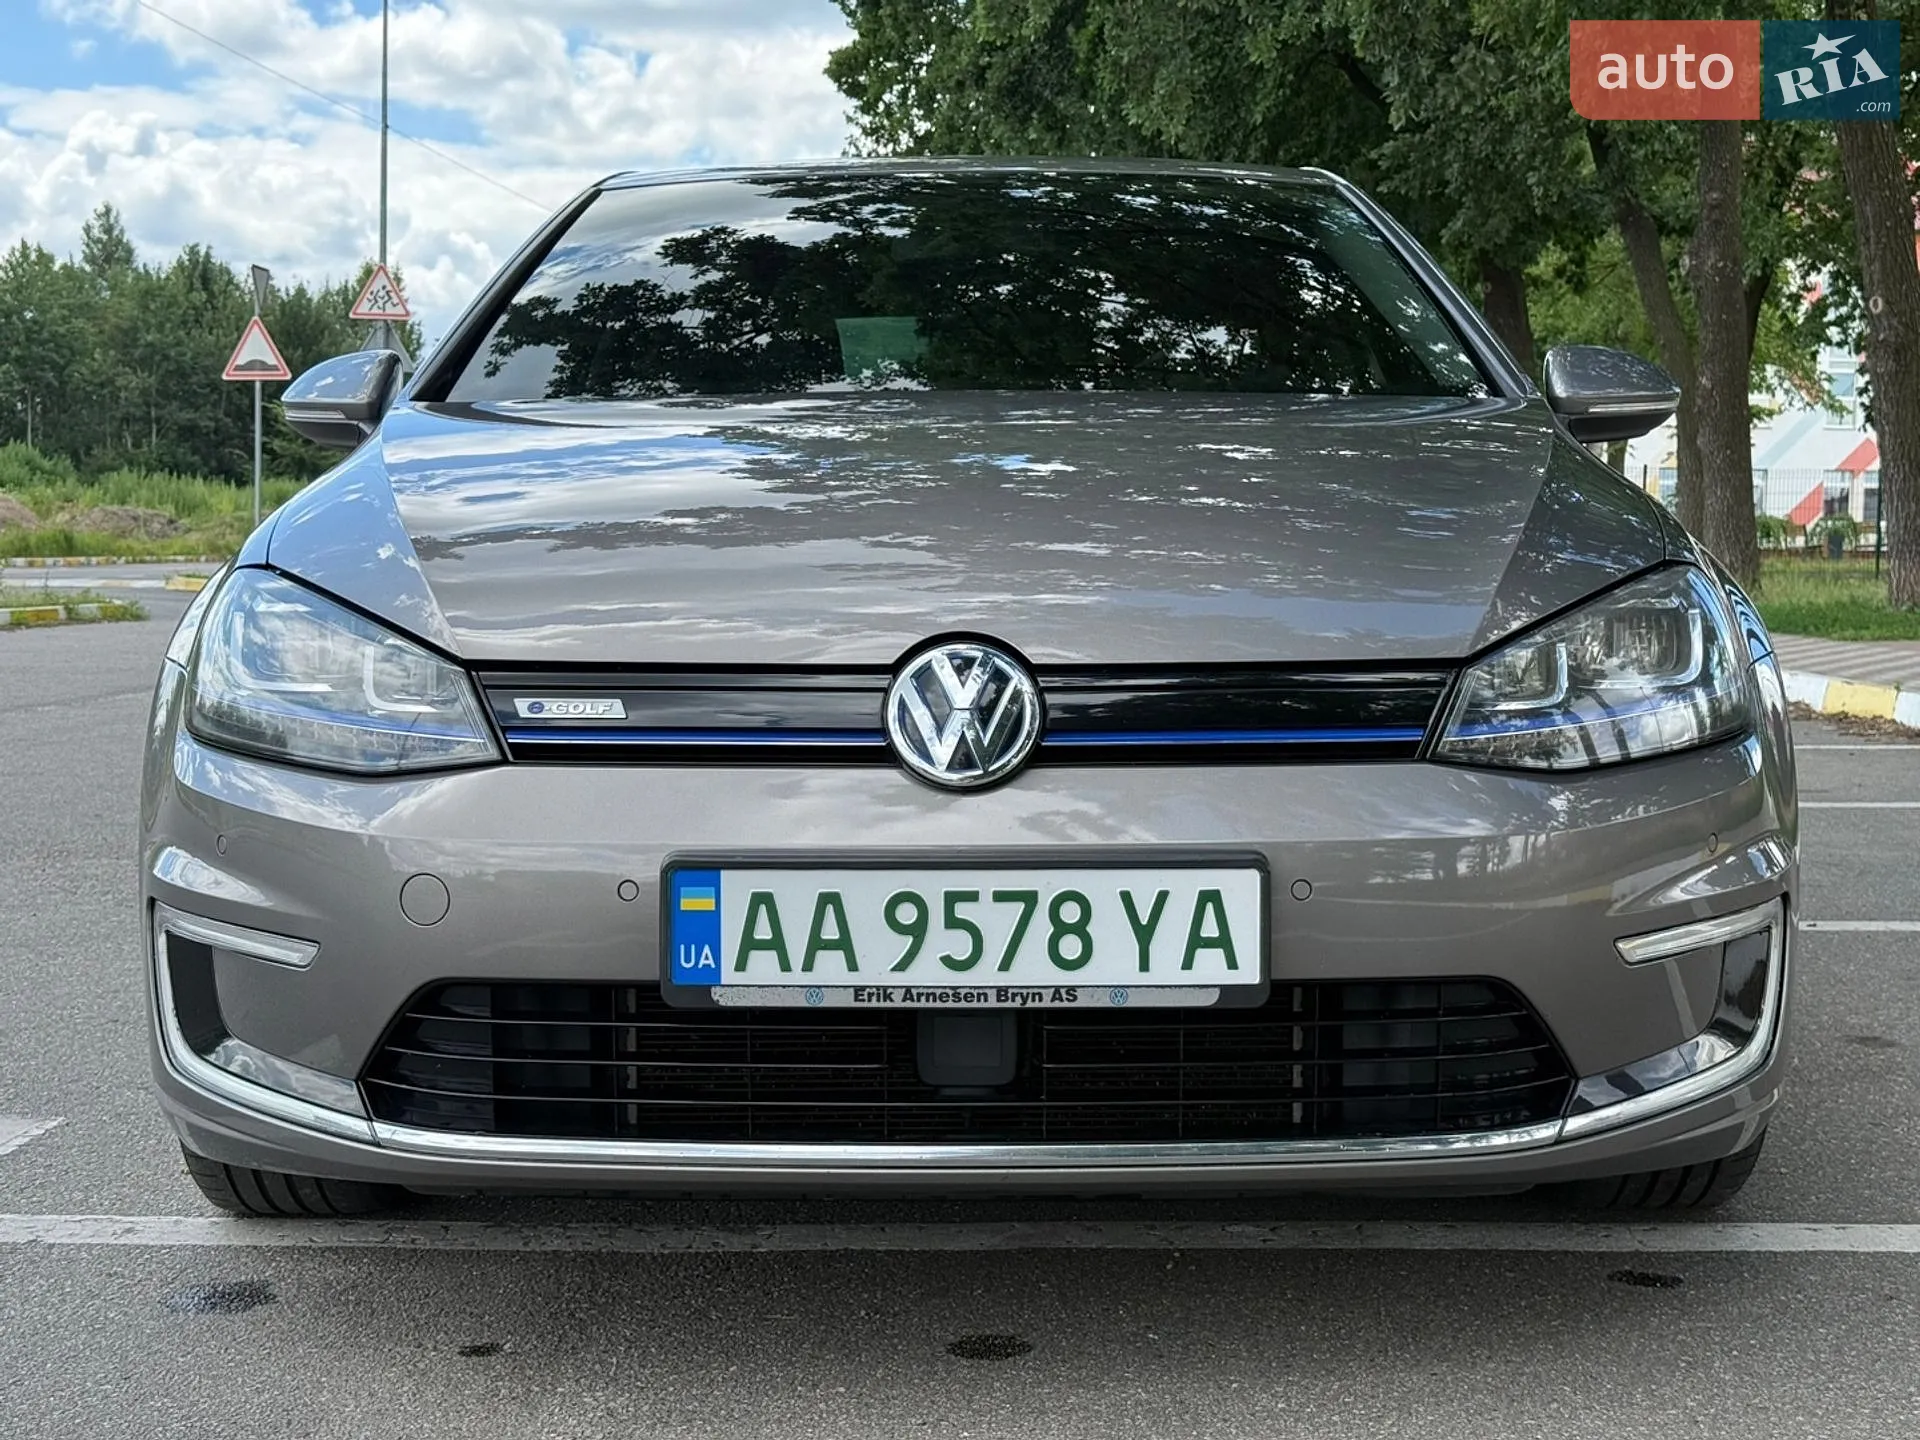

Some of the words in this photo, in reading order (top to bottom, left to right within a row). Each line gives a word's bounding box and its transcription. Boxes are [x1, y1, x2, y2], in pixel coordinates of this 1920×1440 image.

[733, 889, 860, 973] AA
[883, 888, 1094, 973] 9578
[1118, 888, 1240, 972] YA
[680, 944, 716, 969] UA
[853, 988, 894, 1003] Erik
[901, 988, 989, 1003] Arnesen
[995, 988, 1044, 1006] Bryn
[1050, 988, 1079, 1003] AS
